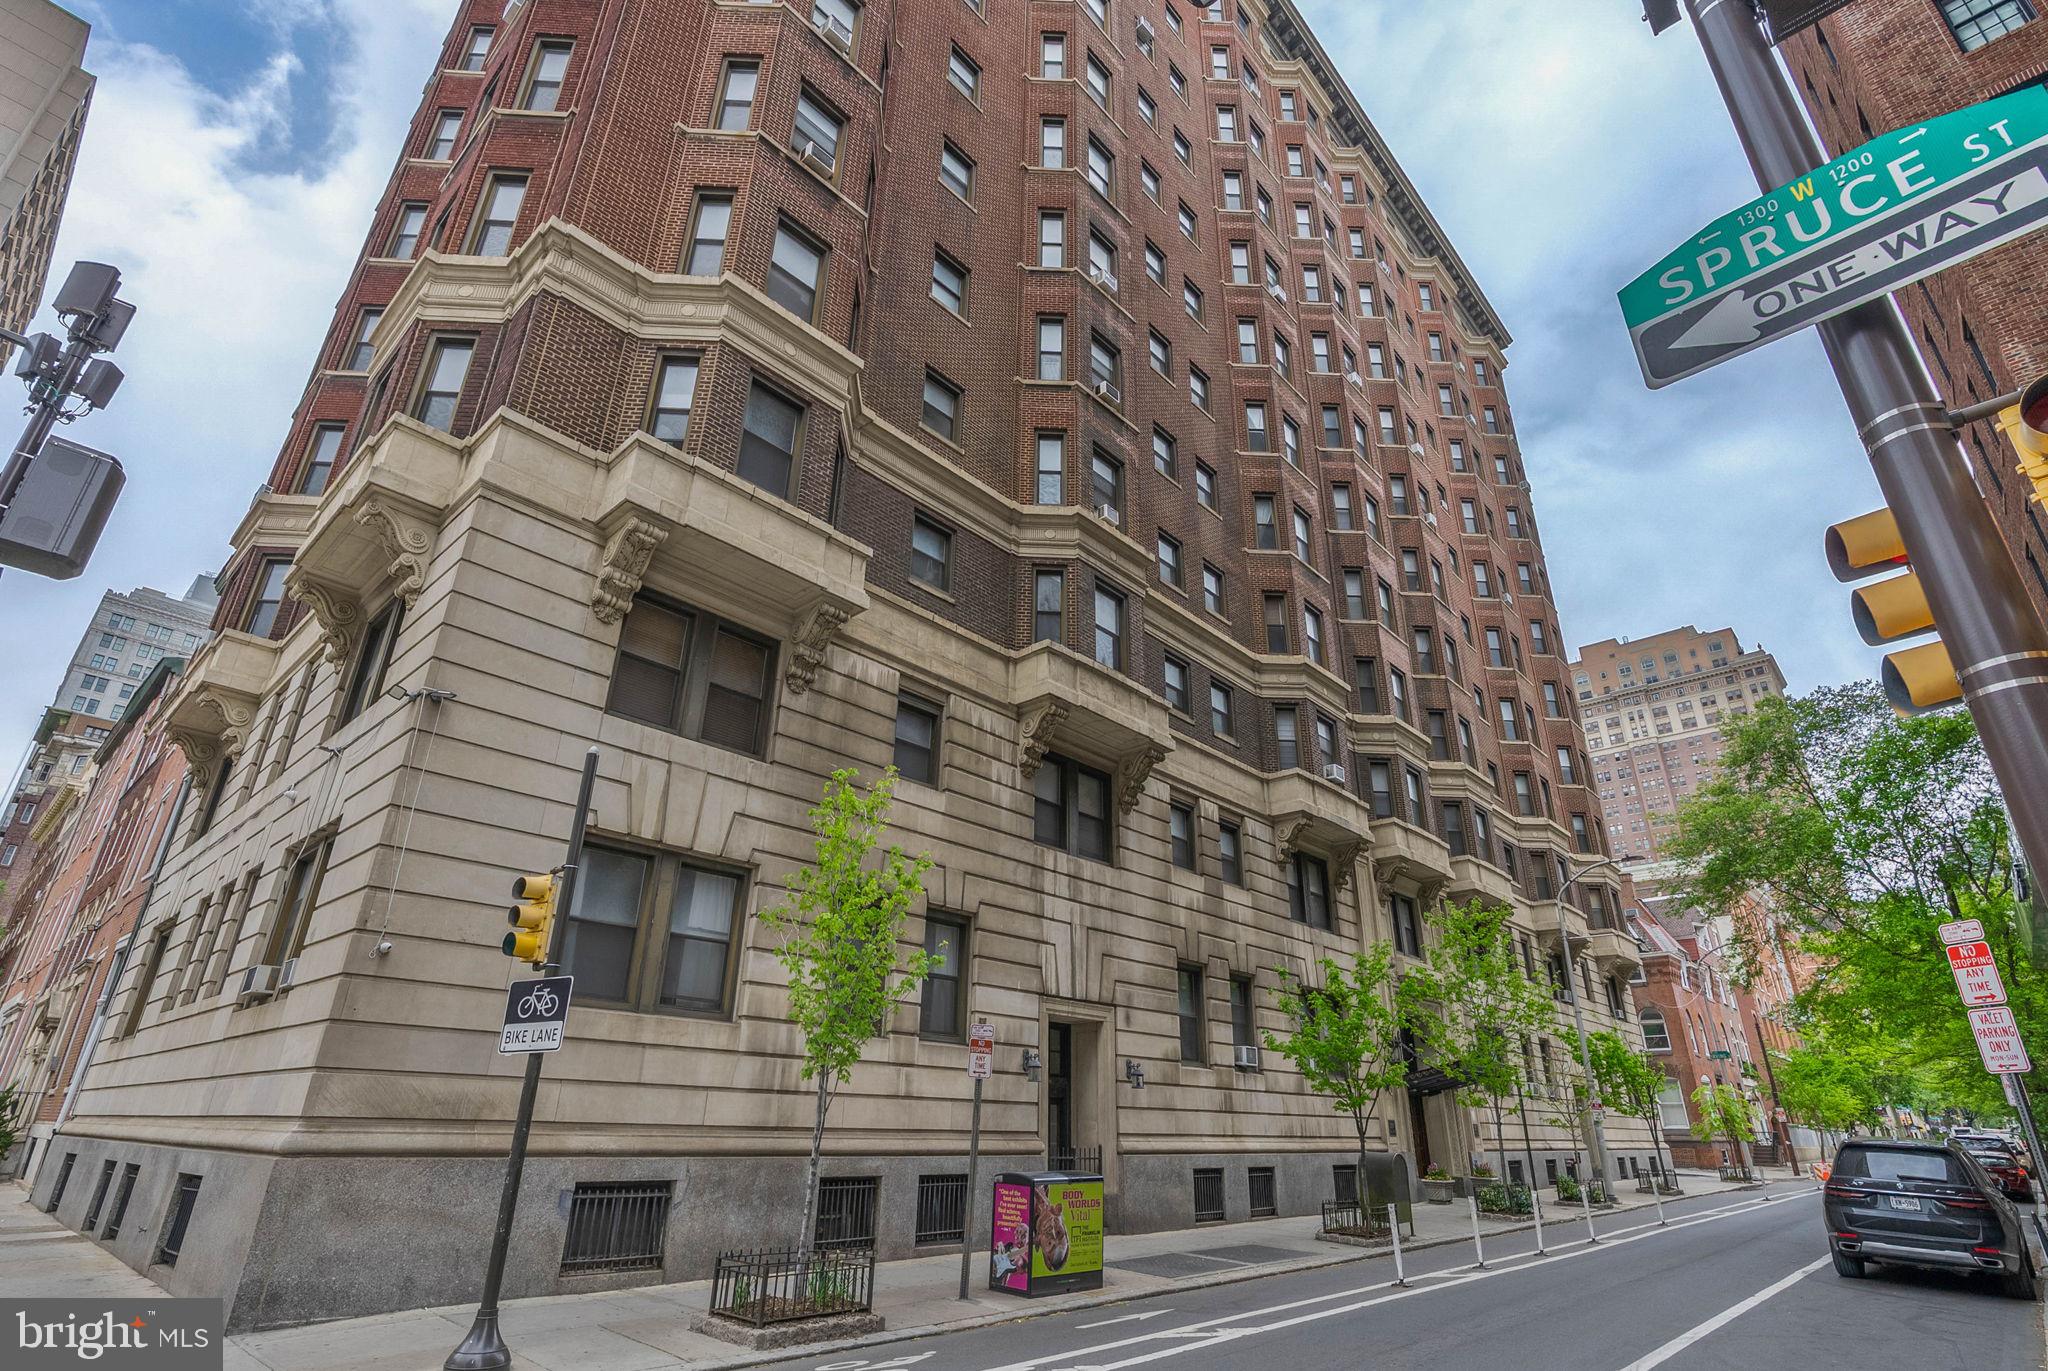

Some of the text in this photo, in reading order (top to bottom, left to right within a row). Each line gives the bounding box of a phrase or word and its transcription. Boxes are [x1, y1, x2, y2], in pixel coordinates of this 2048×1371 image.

[1737, 152, 1873, 227] 1300 W 1200
[1658, 119, 2014, 305] SPRUCE ST
[1753, 181, 2017, 318] ONE WAY
[1959, 945, 1976, 958] NO
[1952, 955, 1992, 969] STOPPING
[1966, 967, 1985, 979] ANY
[1968, 981, 1992, 993] TIME
[1978, 1012, 2005, 1025] VALET
[504, 1028, 558, 1044] BIKE LANE
[1977, 1026, 2015, 1040] PARKING
[971, 1046, 991, 1054] STOPPING
[1988, 1040, 2012, 1053] ONLY
[1062, 1190, 1084, 1200] BODY
[1068, 1199, 1101, 1208] WORLDS
[1071, 1210, 1090, 1221] Vital
